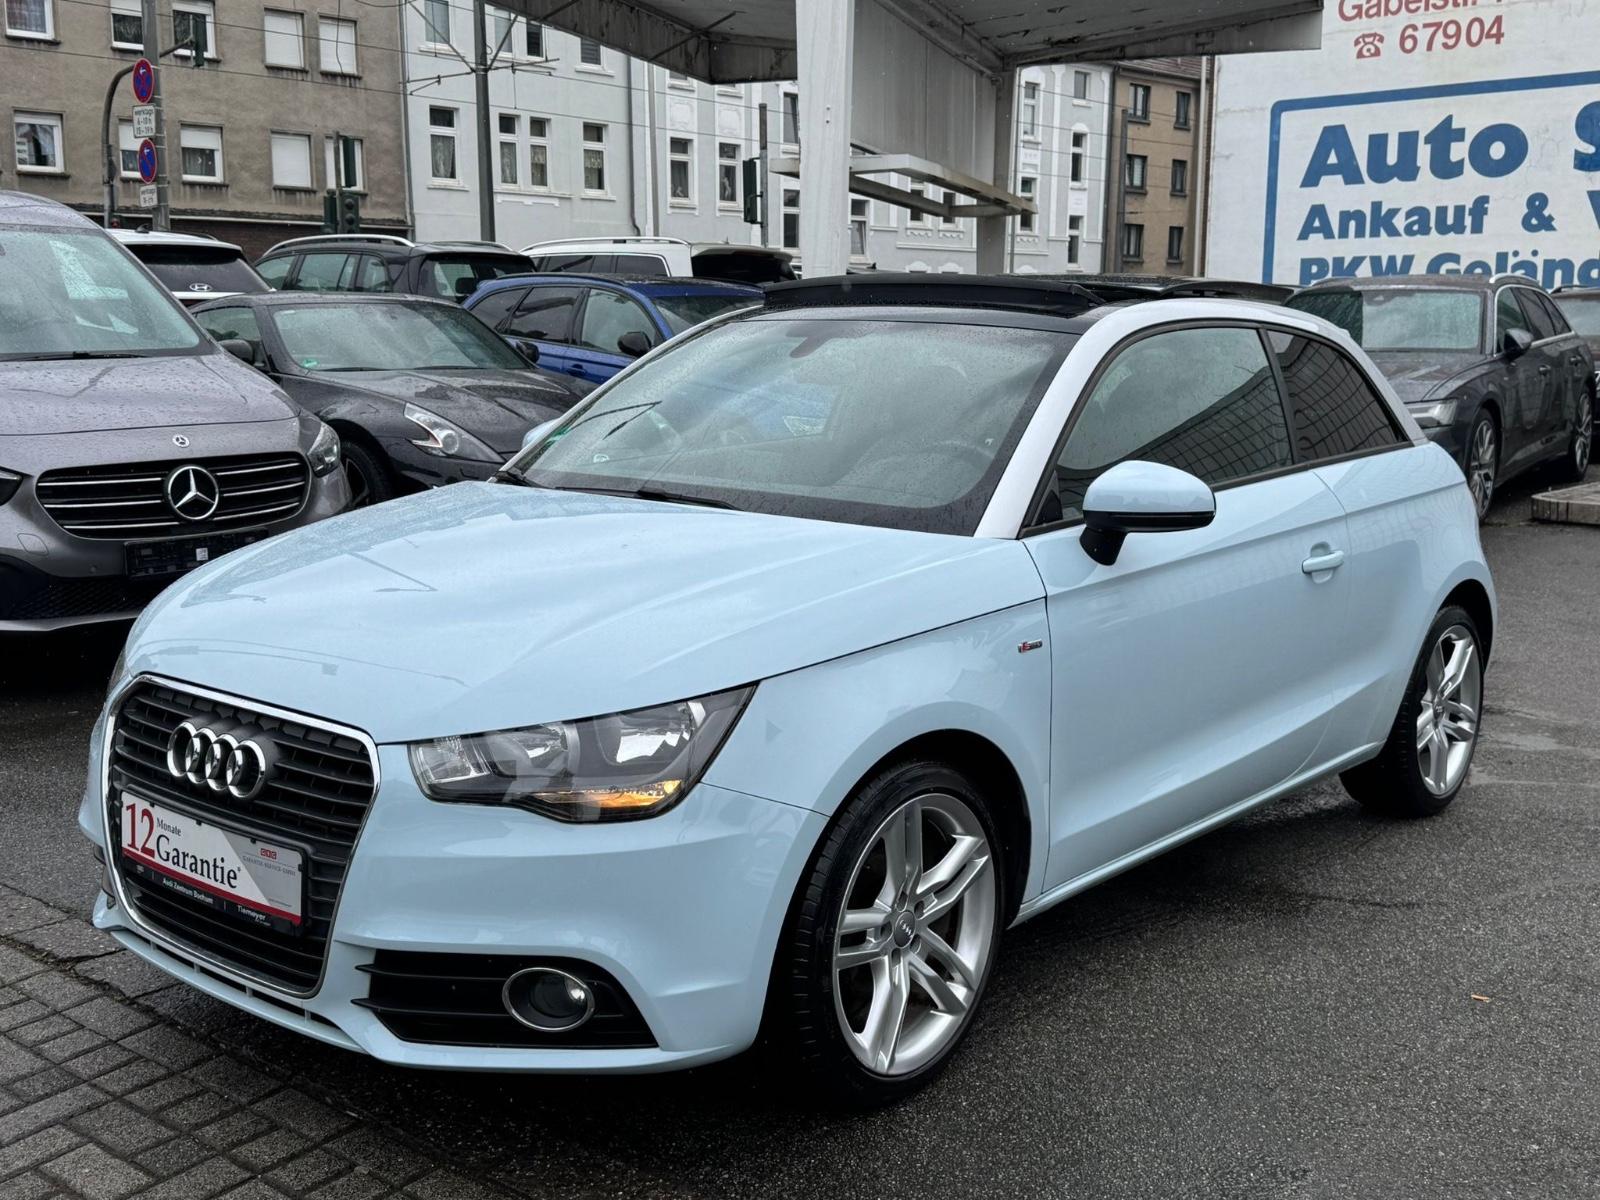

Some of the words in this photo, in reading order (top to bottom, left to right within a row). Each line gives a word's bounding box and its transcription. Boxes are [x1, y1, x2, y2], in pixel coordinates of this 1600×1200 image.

[1399, 15, 1505, 54] 67904
[1299, 114, 1529, 188] Auto
[1297, 195, 1490, 240] Ankauf
[1521, 192, 1557, 234] &
[1300, 254, 1415, 286] PKW
[126, 802, 155, 859] 12
[157, 816, 182, 837] Monate
